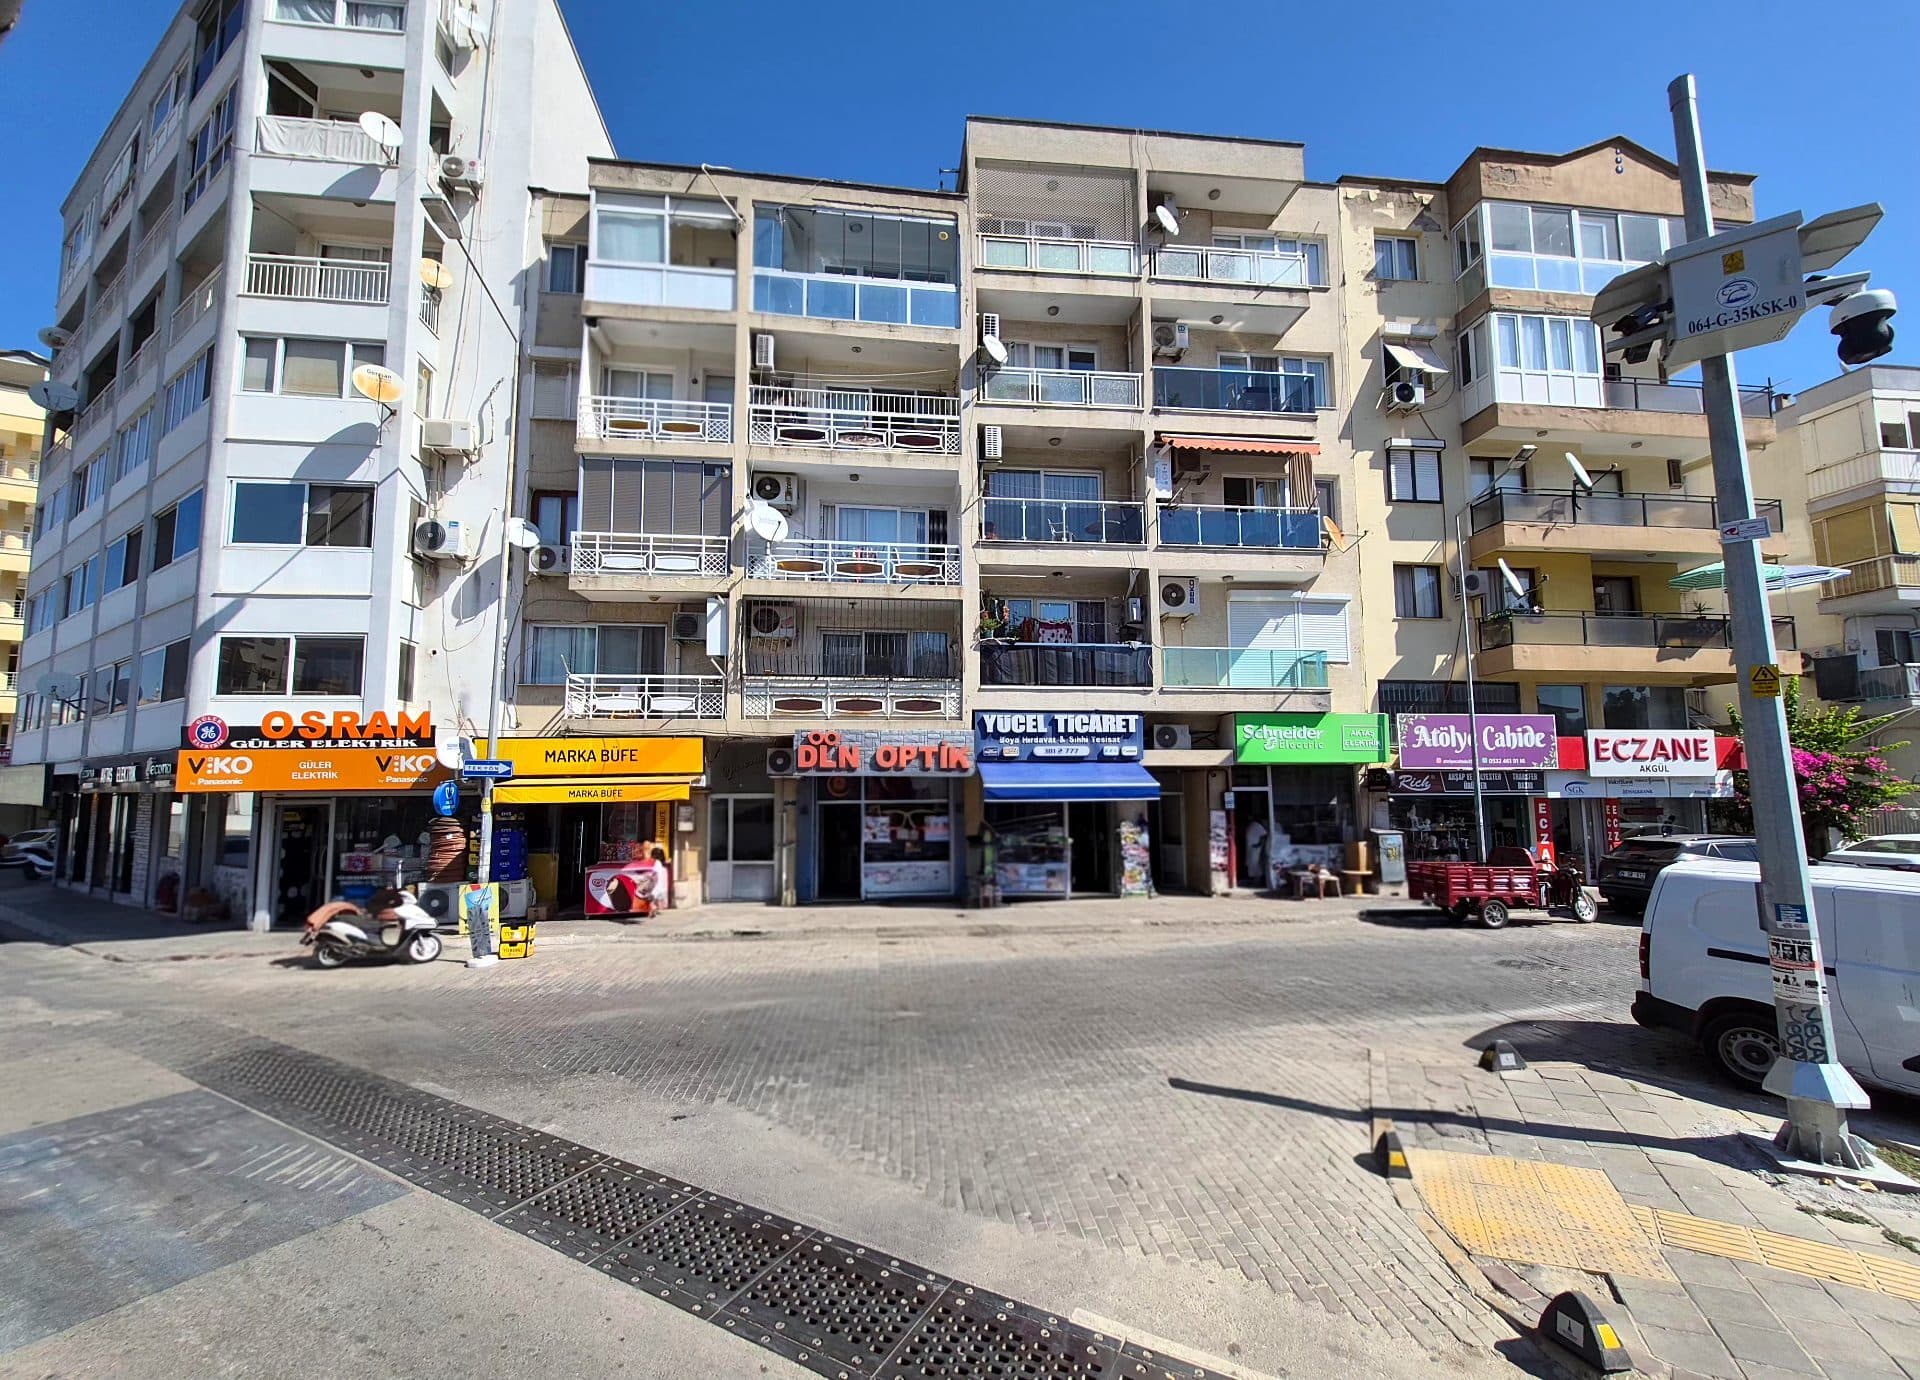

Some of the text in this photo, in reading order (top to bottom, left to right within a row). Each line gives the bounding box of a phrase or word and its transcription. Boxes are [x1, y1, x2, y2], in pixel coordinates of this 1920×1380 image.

[1688, 295, 1797, 334] 064-G-35KSK-0
[261, 710, 432, 739] OSRAM
[983, 714, 1139, 734] YÜCEL TİCARET
[1243, 724, 1325, 740] Schneider
[230, 737, 419, 749] GÜLER ELEKTRİK
[1278, 740, 1325, 750] Electric
[1482, 725, 1546, 751] Cahide
[545, 745, 639, 763] MARKA BÜFE
[875, 740, 971, 769] OPTİK
[1593, 737, 1711, 763] ECZANE
[299, 760, 332, 769] GÜLER
[1640, 763, 1670, 773] AKGÜL
[291, 769, 339, 780] ELEKTRİK
[385, 775, 428, 783] Panasonic
[1398, 775, 1432, 791] Rich
[1568, 785, 1585, 794] SGK
[568, 789, 598, 798] MARKA
[1538, 803, 1552, 872] ECZAN
